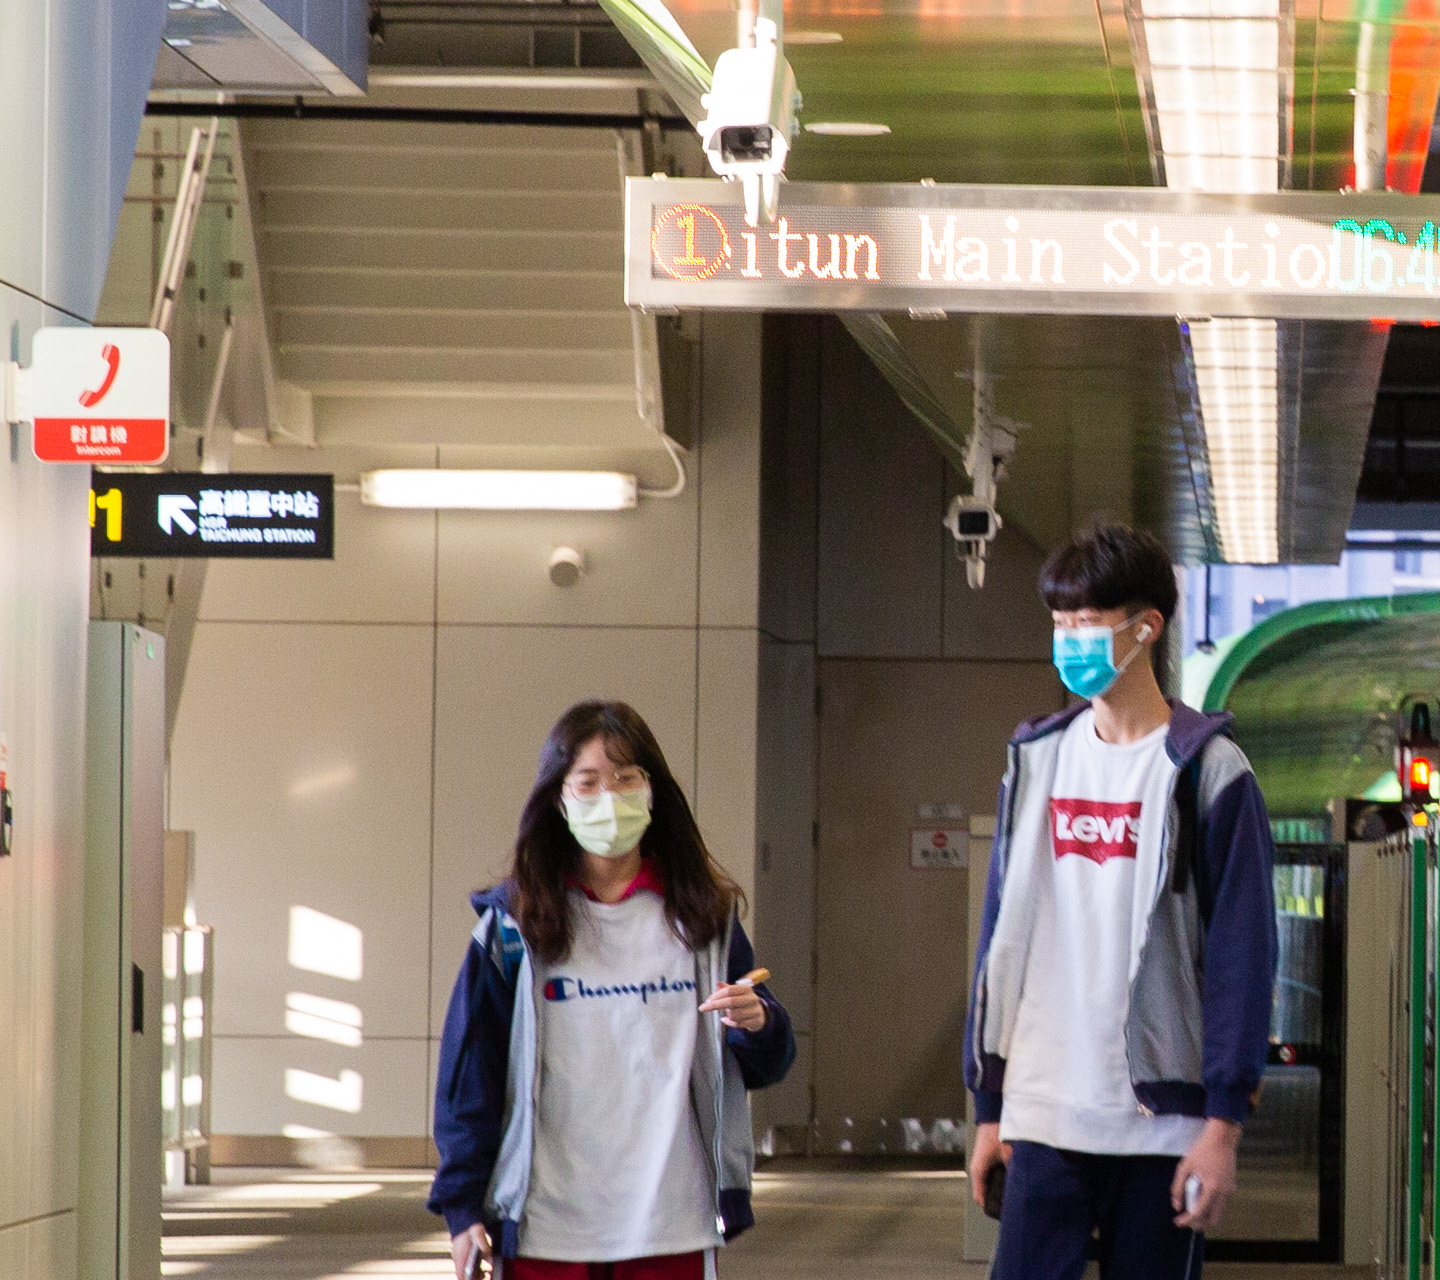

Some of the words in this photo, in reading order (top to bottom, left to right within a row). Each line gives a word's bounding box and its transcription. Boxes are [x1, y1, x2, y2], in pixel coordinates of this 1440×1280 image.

[725, 213, 881, 281] itun
[916, 213, 1066, 285] Main
[1102, 216, 1336, 290] Statio
[96, 488, 123, 542] 1
[199, 527, 263, 543] TAICHUNG
[263, 528, 317, 544] STATION
[1055, 809, 1140, 845] Levi's
[544, 975, 697, 1004] Champion
